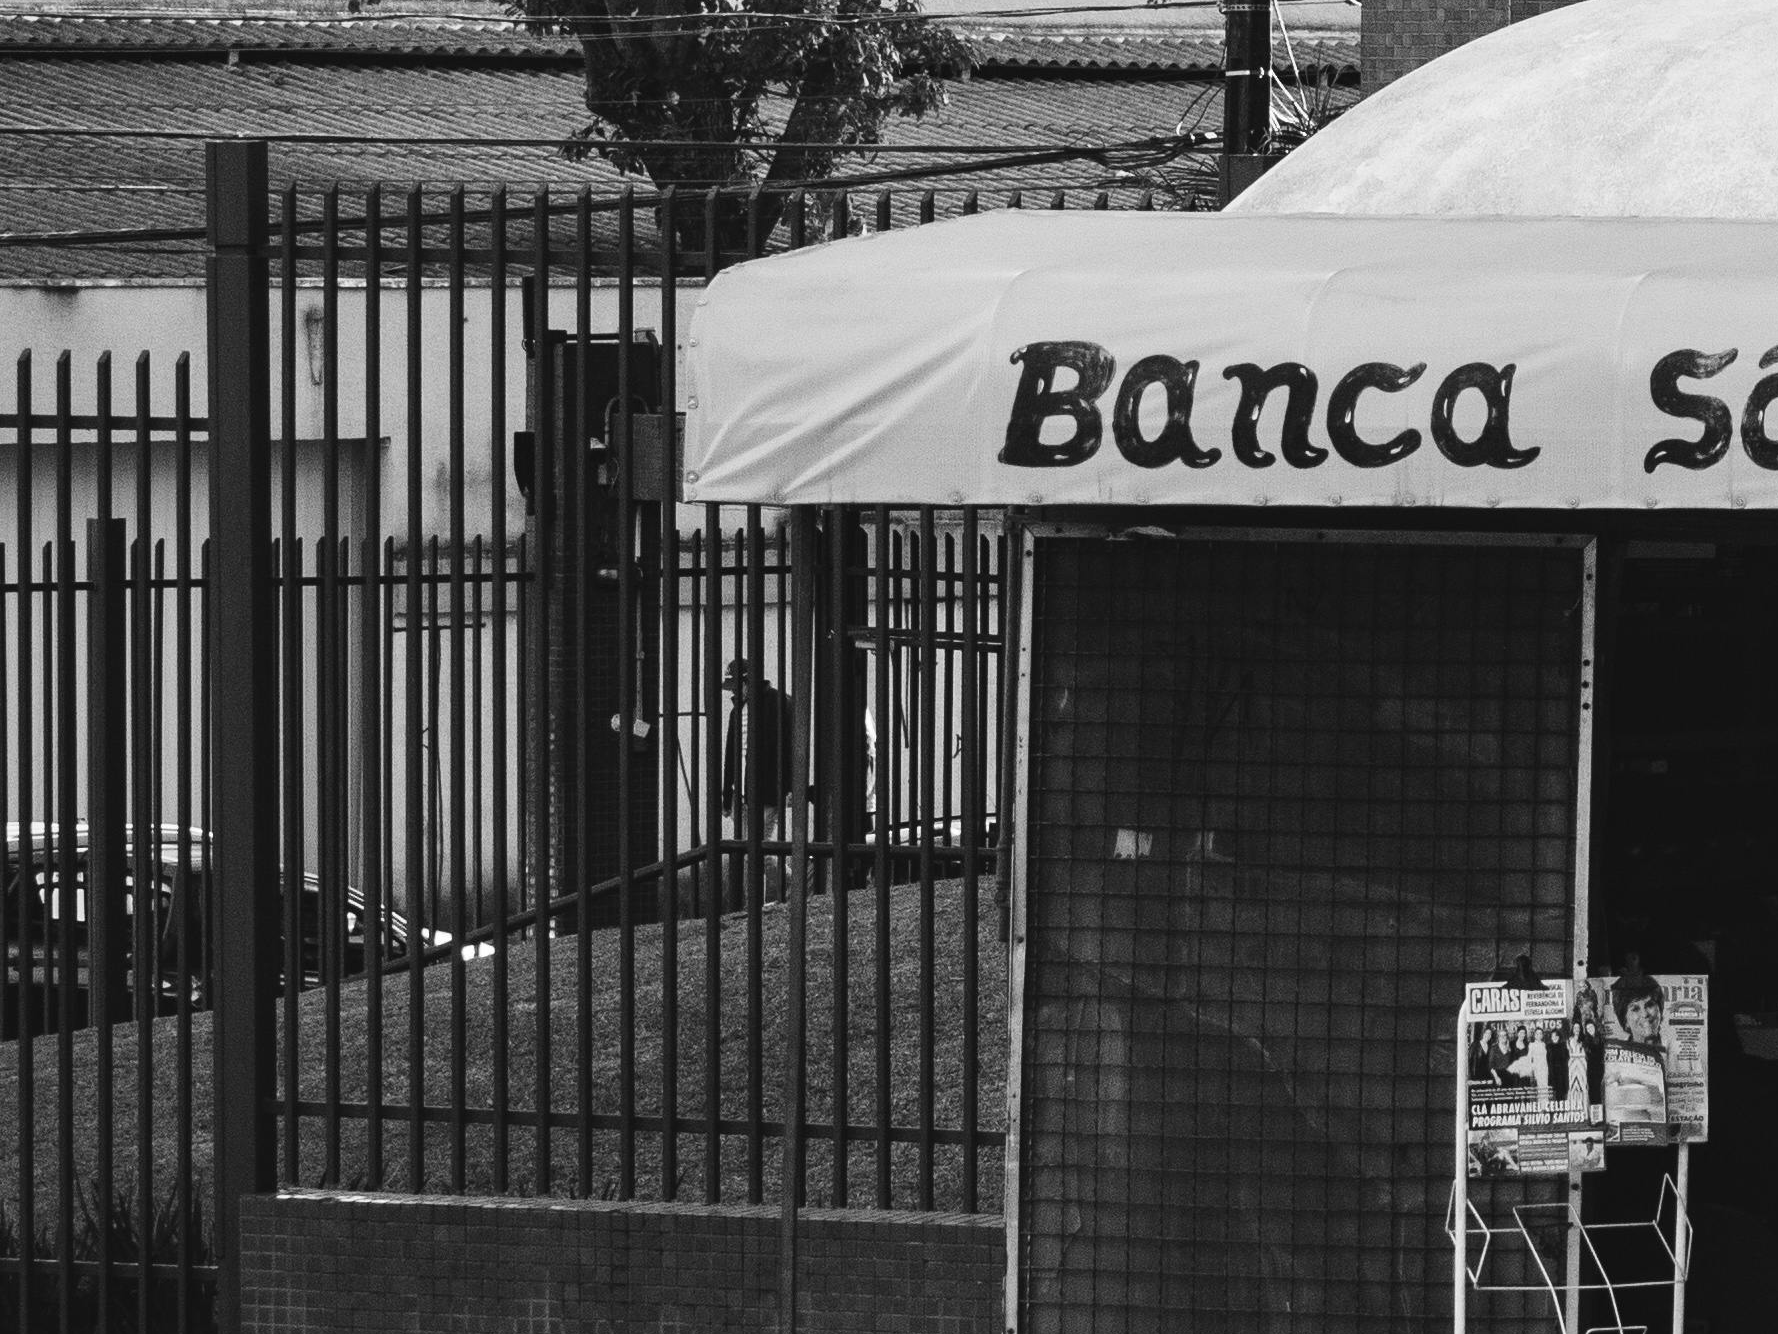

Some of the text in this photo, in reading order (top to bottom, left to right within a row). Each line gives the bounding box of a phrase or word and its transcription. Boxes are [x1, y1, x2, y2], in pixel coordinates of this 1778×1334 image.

[998, 342, 1540, 474] Banca
[1471, 988, 1521, 1013] CARAS
[1490, 1102, 1544, 1114] ABRAVANEL
[1472, 1111, 1585, 1127] PROGRAMA SILVIO SANTOS
